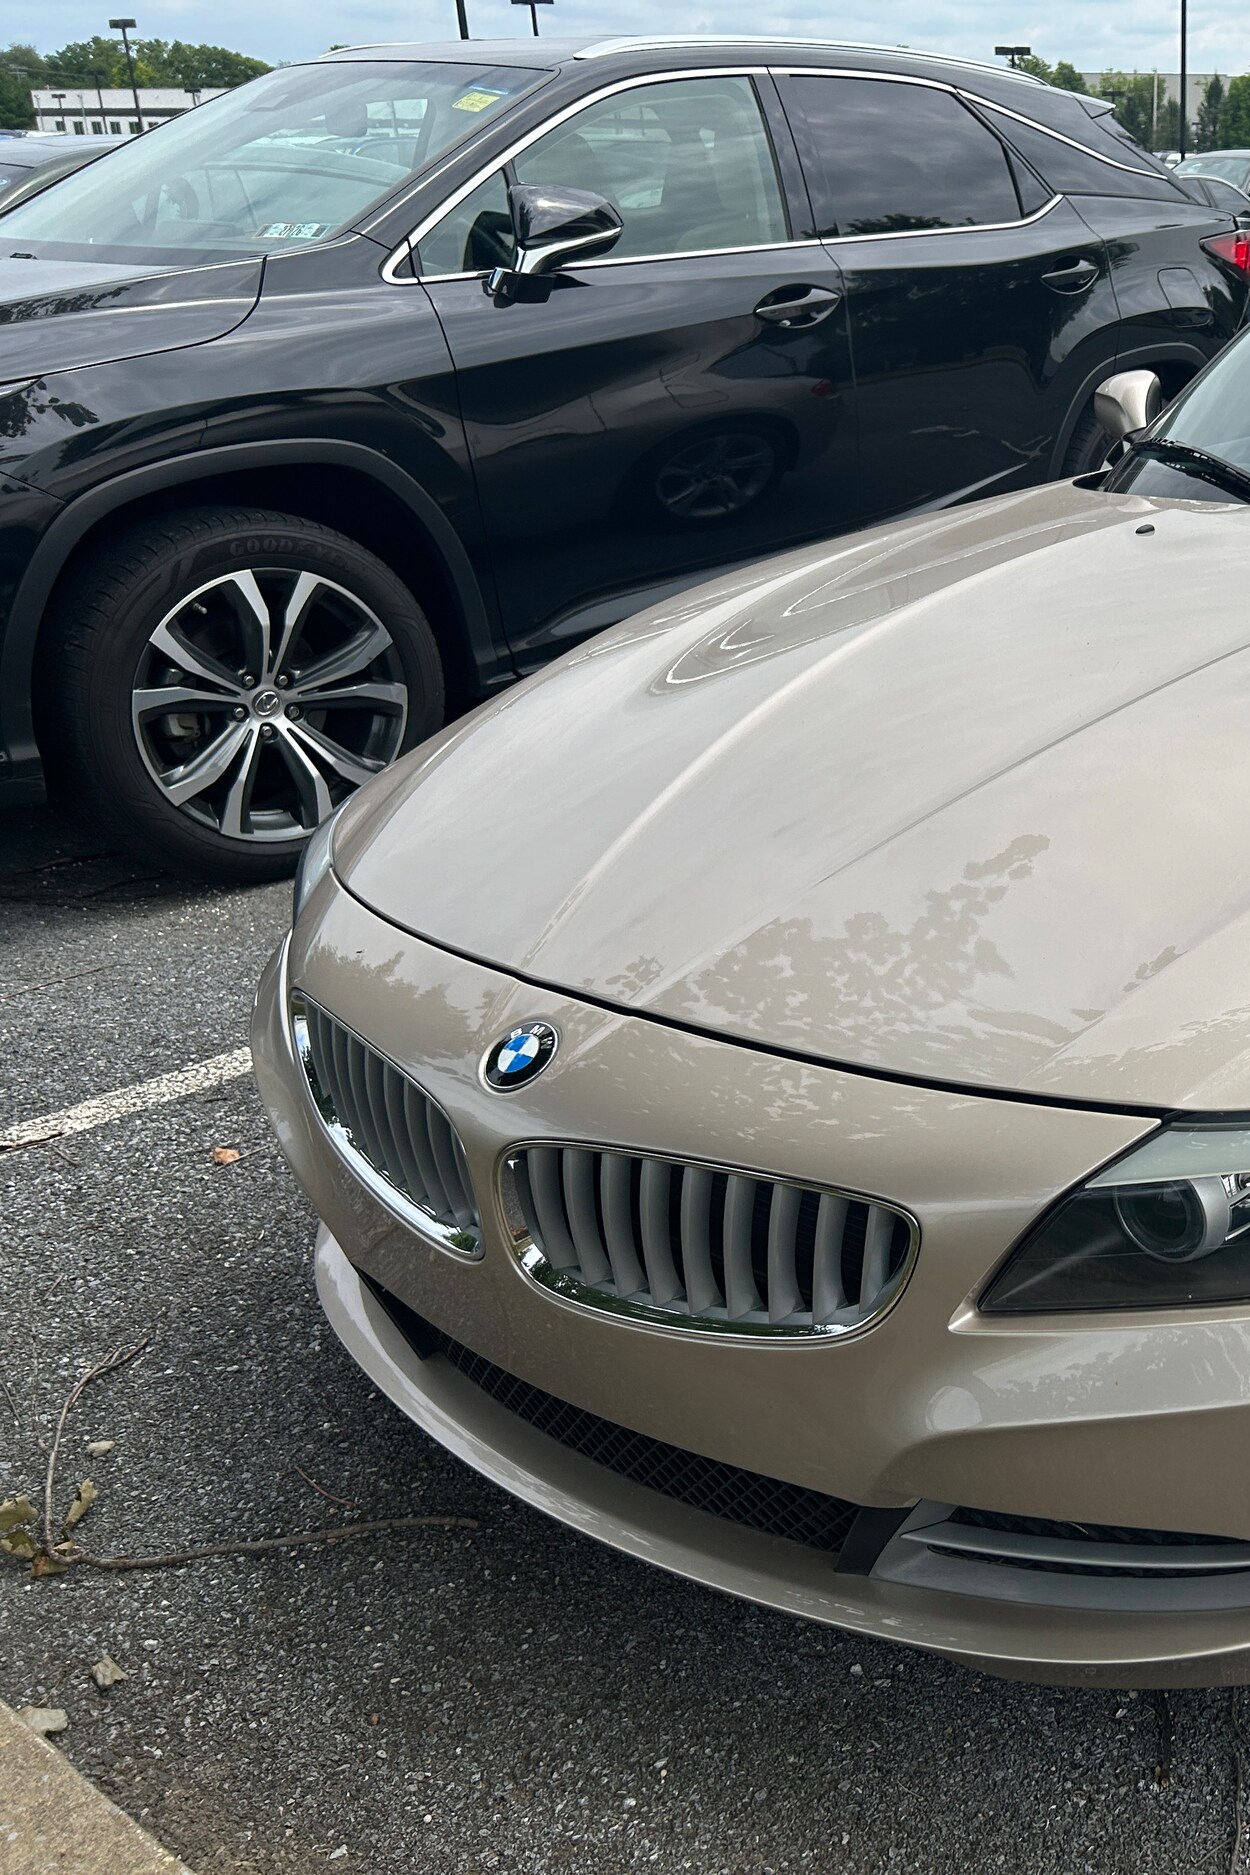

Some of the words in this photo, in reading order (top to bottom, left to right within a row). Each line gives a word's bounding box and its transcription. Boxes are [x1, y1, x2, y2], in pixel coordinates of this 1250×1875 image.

[279, 225, 292, 236] 27
[292, 225, 306, 236] 26
[510, 1024, 553, 1049] BMW
